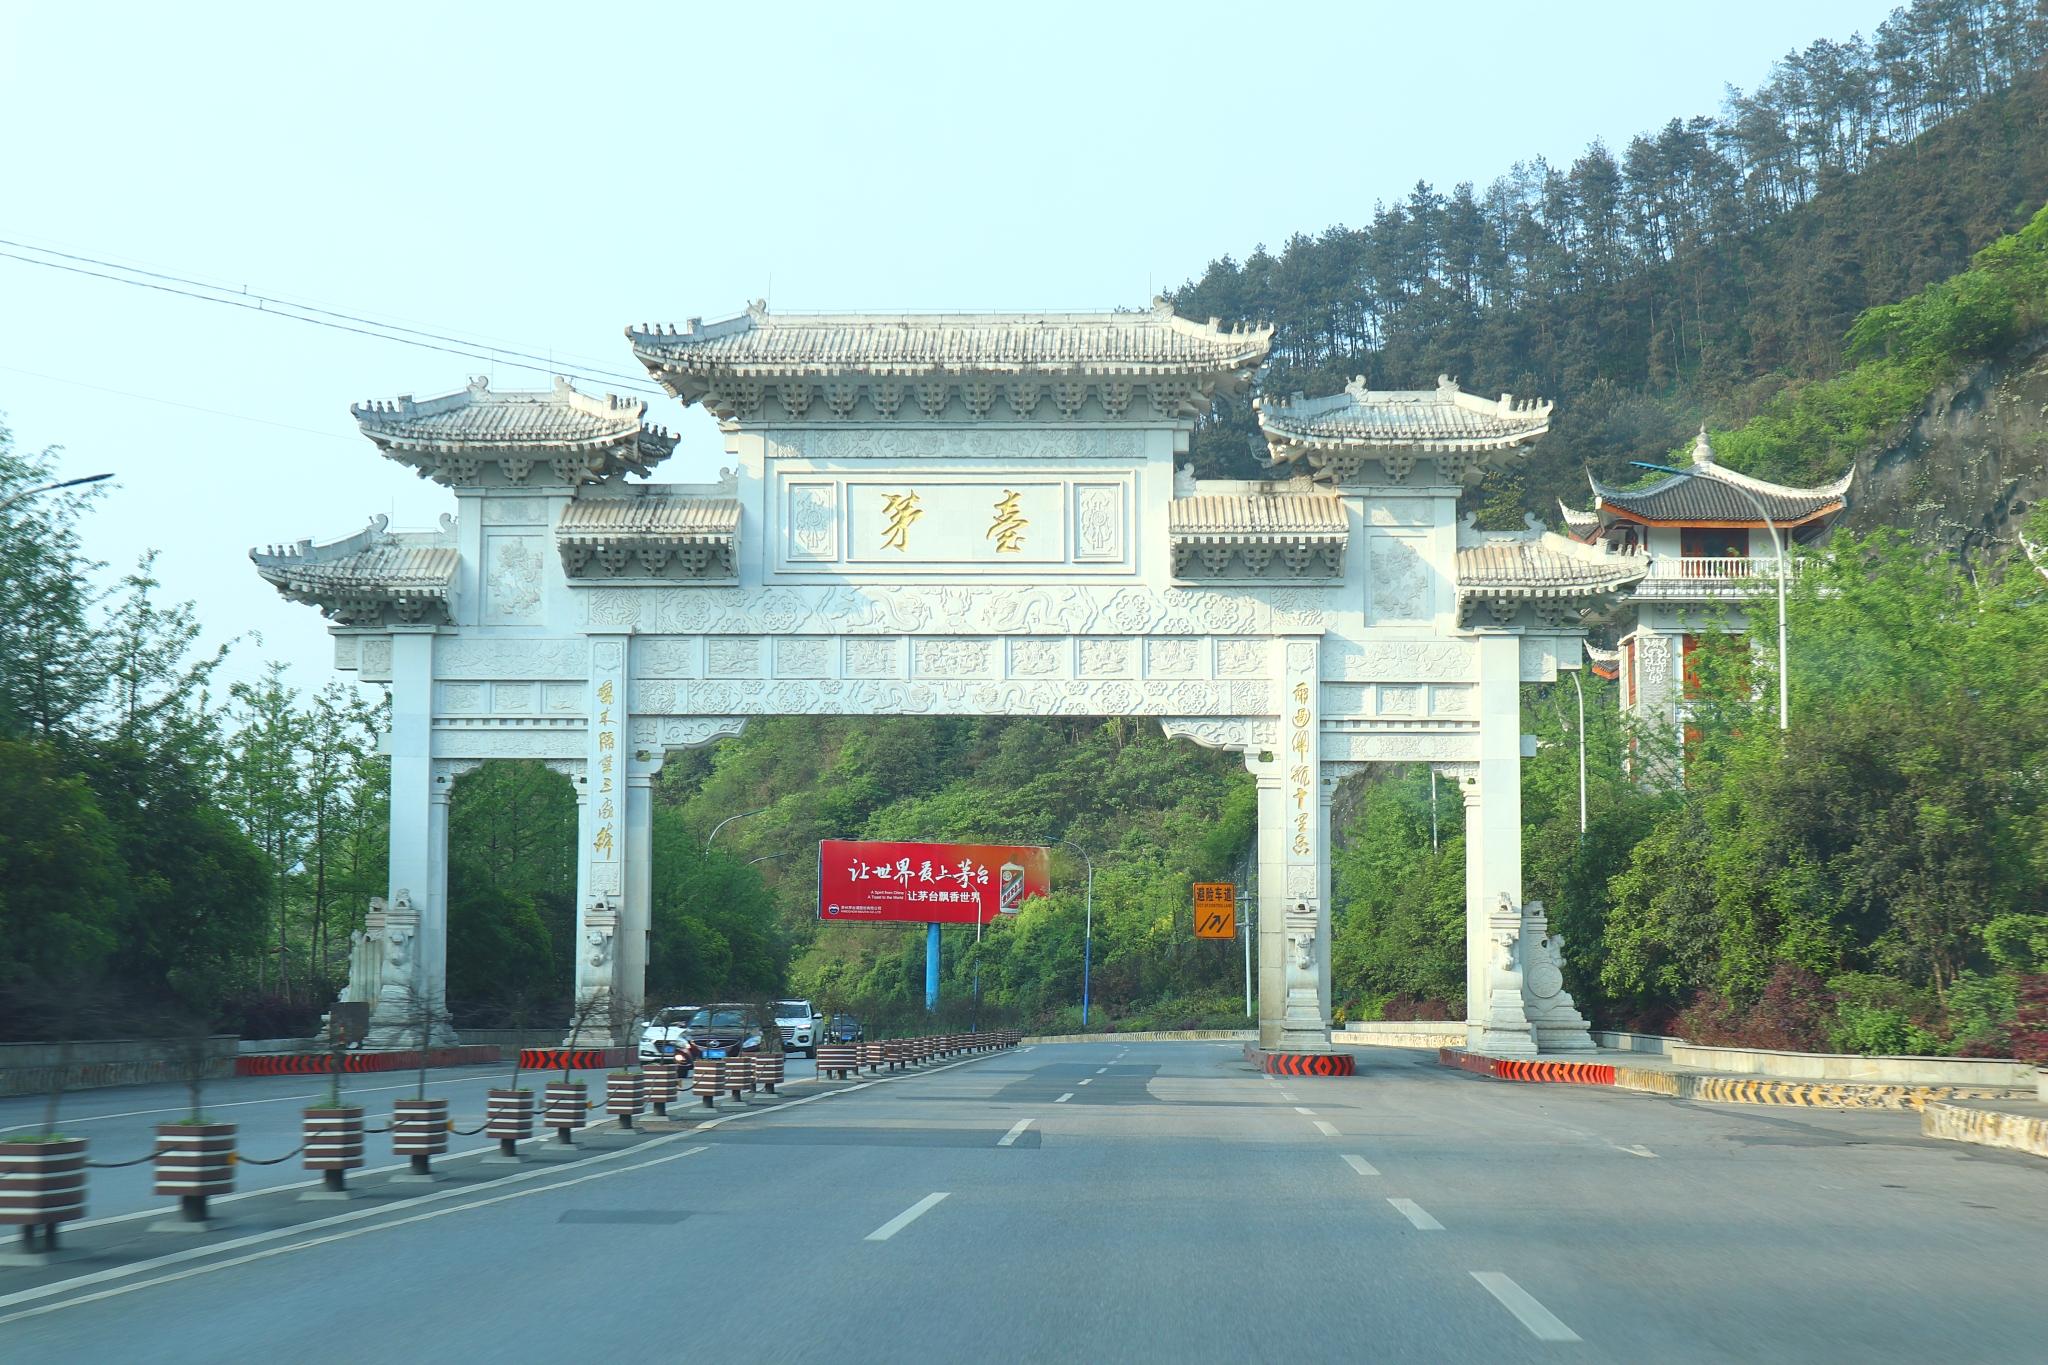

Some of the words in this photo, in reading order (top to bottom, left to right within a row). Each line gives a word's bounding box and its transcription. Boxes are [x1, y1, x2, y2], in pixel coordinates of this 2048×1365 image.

[848, 857, 989, 888] 让世界爱上茅台
[907, 890, 980, 903] 让茅台飘香世界
